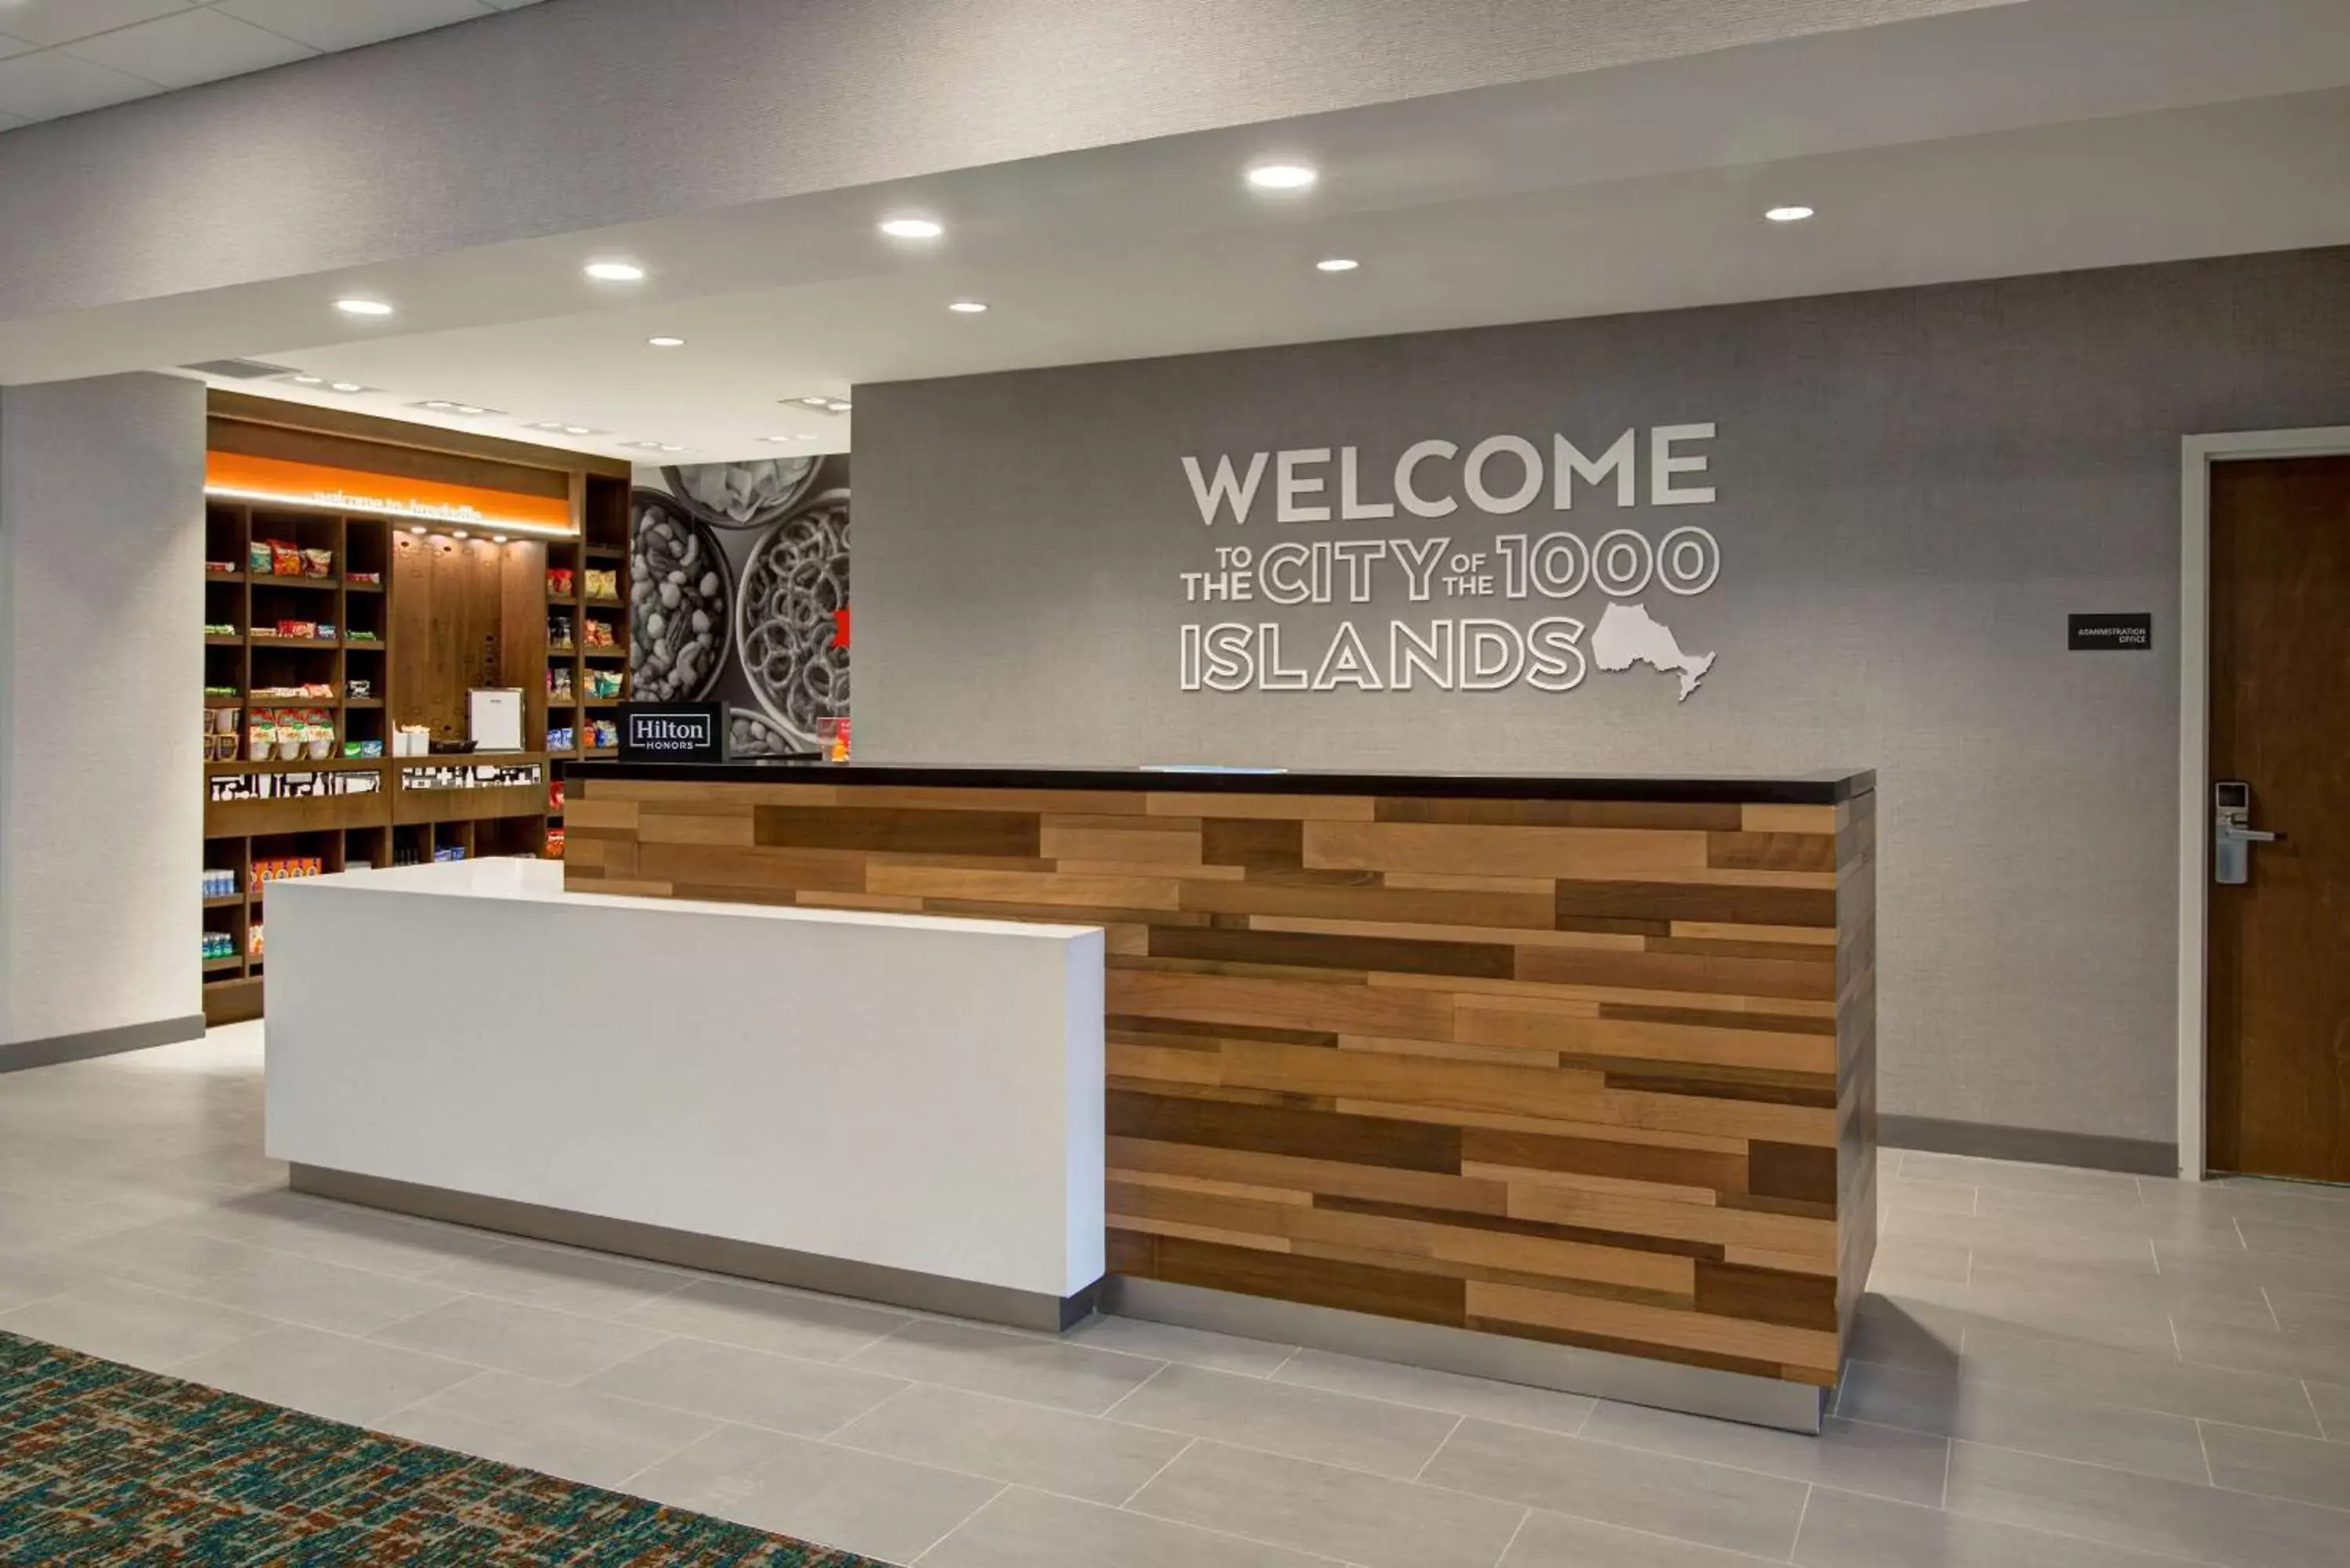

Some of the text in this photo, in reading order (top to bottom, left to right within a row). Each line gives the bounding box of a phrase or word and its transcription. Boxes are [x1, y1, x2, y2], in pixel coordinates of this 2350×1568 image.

[1181, 422, 1716, 526] WELCOME
[1180, 526, 1720, 604] TO THE CITY OF THE 1000
[1180, 616, 1587, 692] ISLANDS
[637, 720, 703, 739] Hilton
